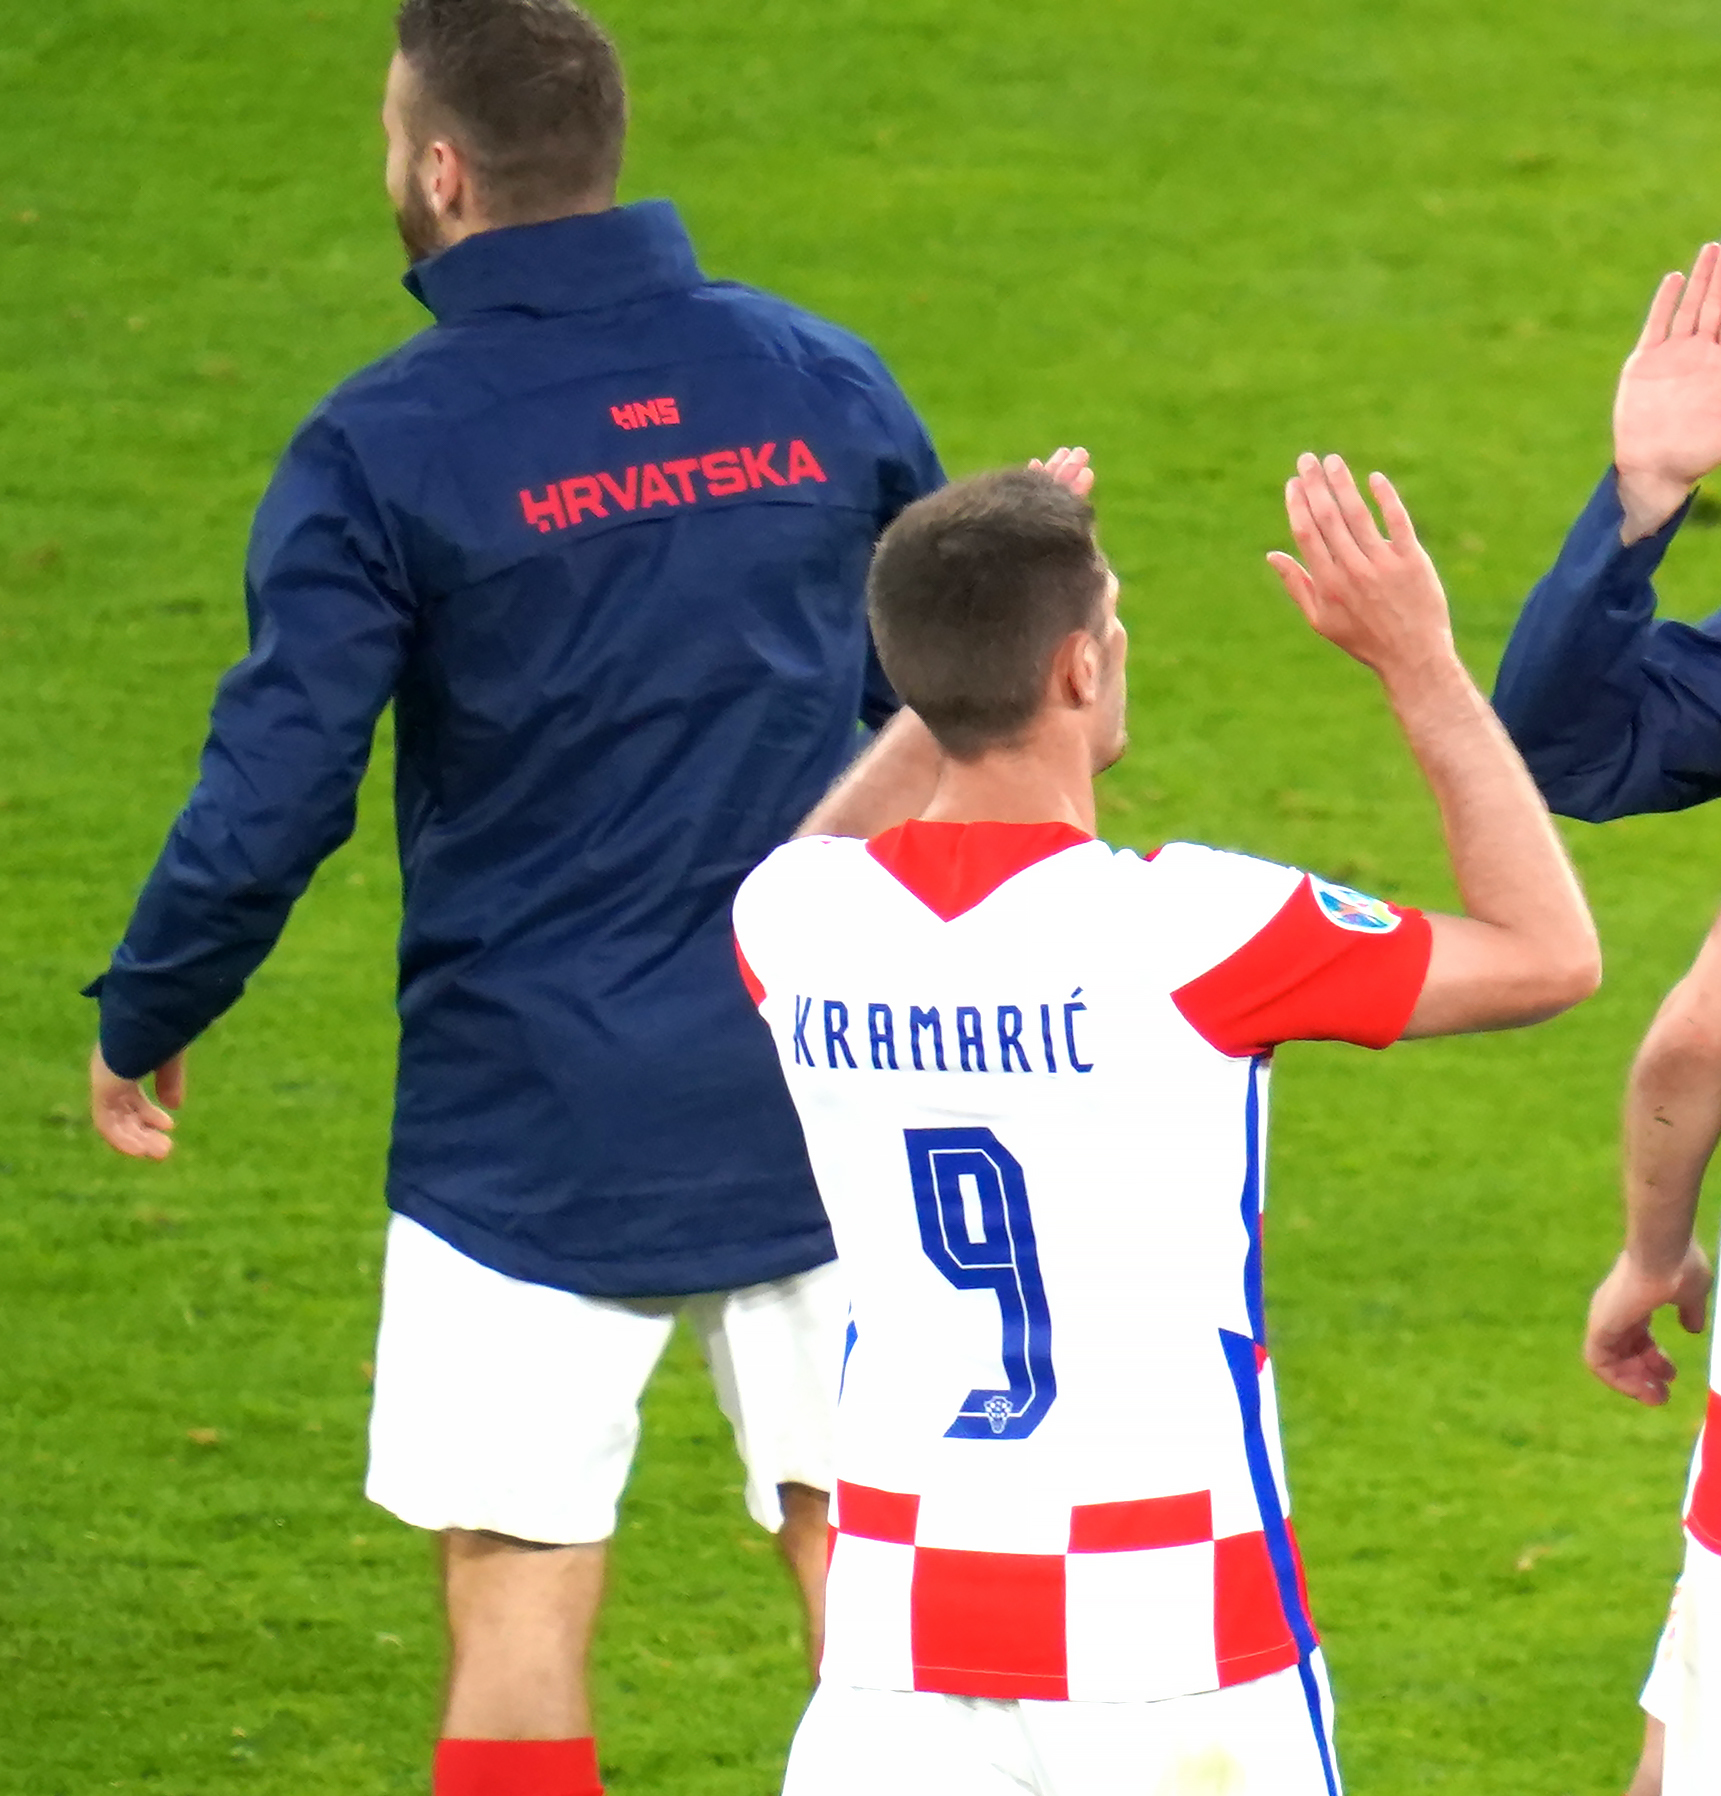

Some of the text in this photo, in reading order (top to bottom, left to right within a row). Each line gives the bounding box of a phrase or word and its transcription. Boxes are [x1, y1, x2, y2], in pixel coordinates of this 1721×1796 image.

[610, 397, 680, 430] HNS
[519, 439, 828, 533] HRVATSKA
[794, 986, 1094, 1074] KRAMARIĆ
[904, 1126, 1057, 1439] 9
